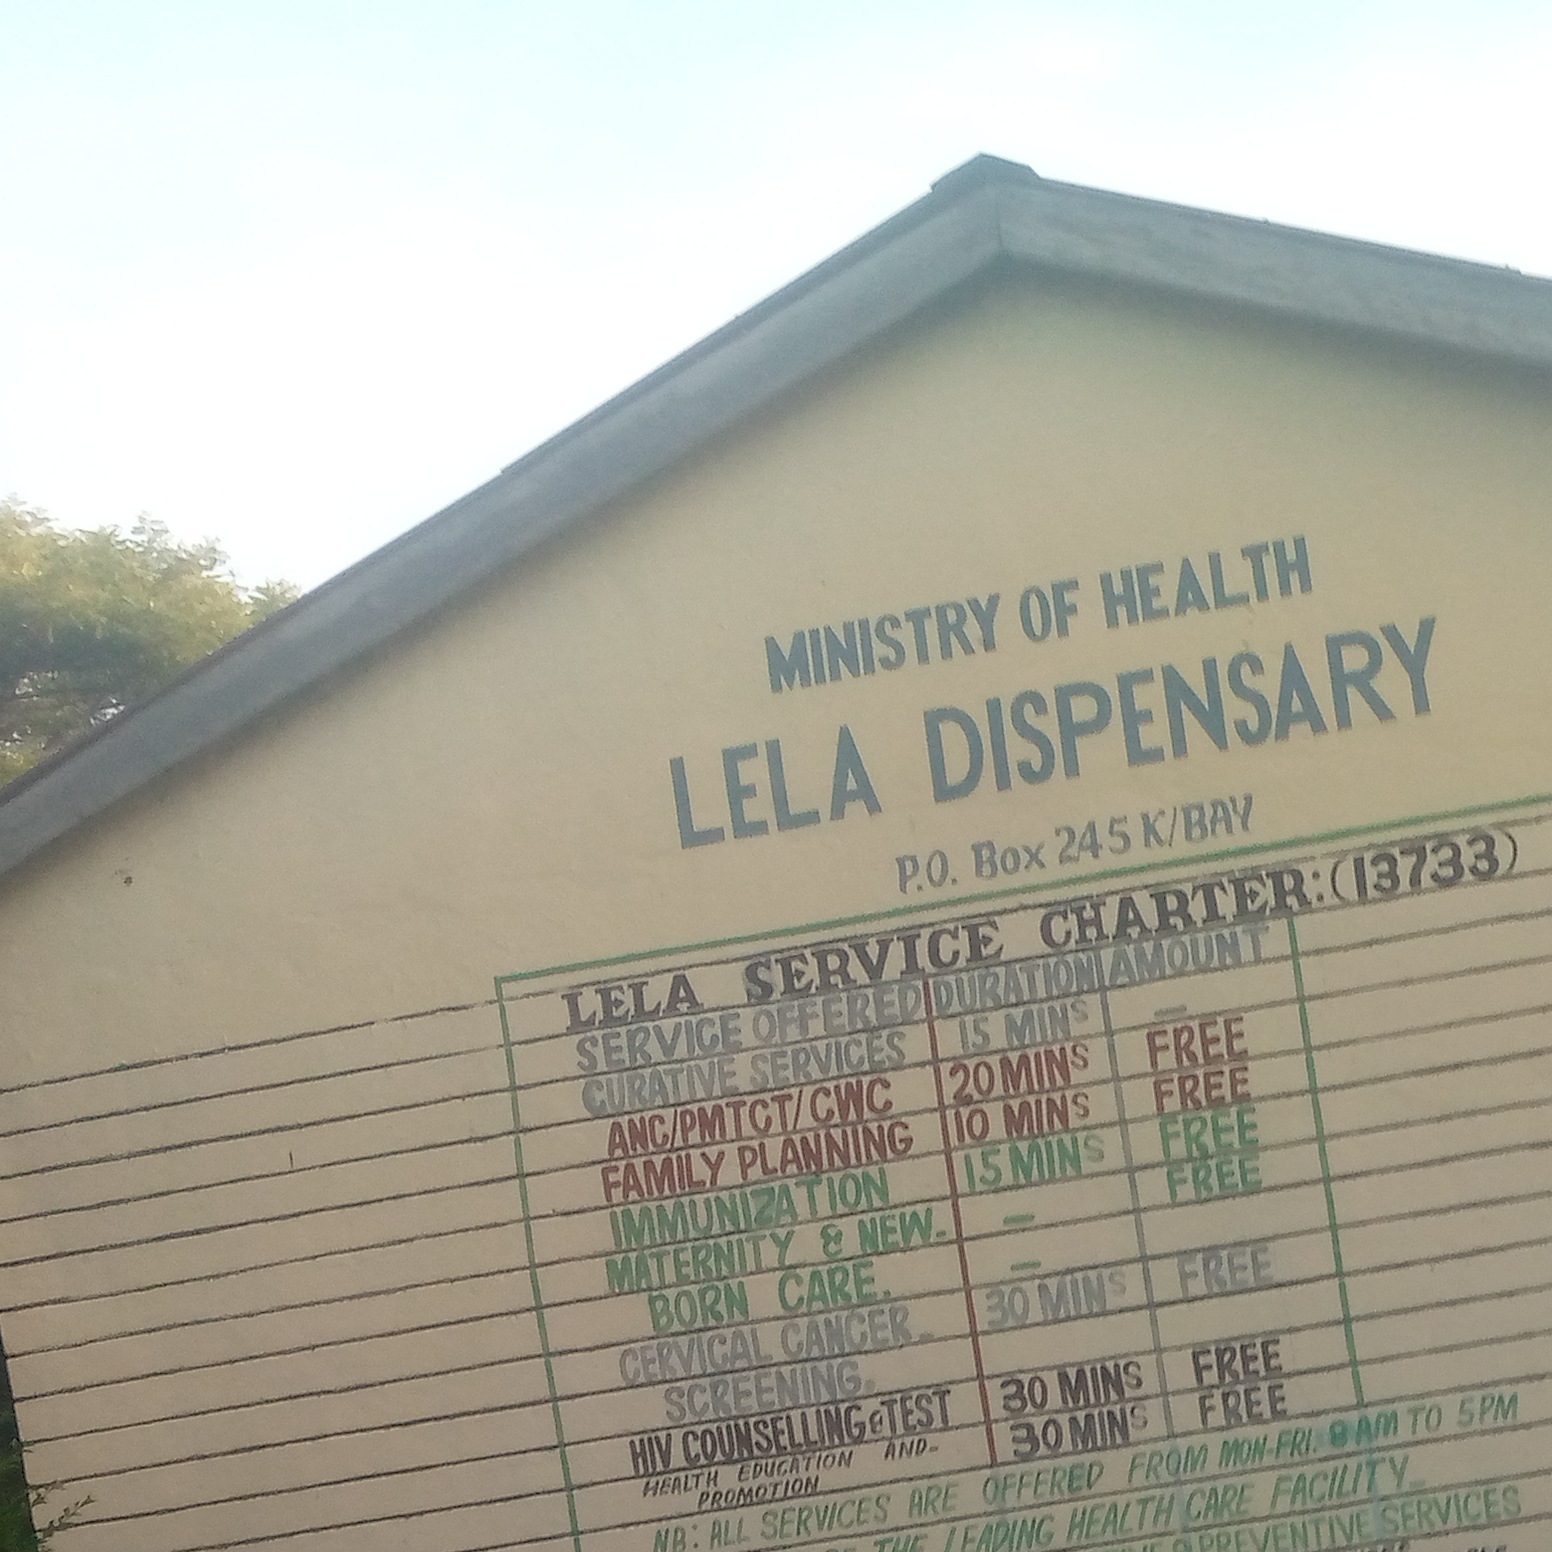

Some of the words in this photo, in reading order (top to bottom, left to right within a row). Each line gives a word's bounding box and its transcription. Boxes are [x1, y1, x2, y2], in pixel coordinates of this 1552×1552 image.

[764, 593, 1000, 693] MINISTRY
[1019, 579, 1080, 643] OF
[1101, 534, 1314, 631] HEALTH
[668, 724, 883, 851] LELA
[922, 616, 1438, 803] DISPENSARY
[896, 849, 958, 894] P.O.
[971, 840, 1046, 880] Box
[1054, 816, 1132, 865] 245
[1142, 795, 1254, 847] K/BAY
[560, 973, 704, 1034] LELA
[743, 916, 1004, 1003] SERVICE
[1108, 923, 1270, 985] AMOUNT
[933, 955, 1097, 1019] DURATION
[576, 1011, 742, 1073] SERVICE
[751, 980, 922, 1043] OFFERED
[959, 1015, 991, 1054] 15
[1004, 1000, 1089, 1047] MINS
[1145, 1016, 1249, 1071] FREE
[582, 1058, 739, 1117] CURATIVE
[750, 1030, 906, 1088] SERVICES
[949, 1060, 996, 1103] 20
[999, 1042, 1090, 1096] MINS
[1152, 1066, 1251, 1115] FREE
[606, 1077, 894, 1159] ANC/PMTCT/CWC
[953, 1107, 990, 1145] 10
[1002, 1091, 1091, 1138] MINS
[1158, 1104, 1260, 1162] FREE
[600, 1148, 726, 1203] FAMILY
[737, 1120, 915, 1181] PLANNING
[964, 1147, 1002, 1192] 15
[1008, 1132, 1105, 1183] MINS
[1164, 1152, 1263, 1202] FREE
[608, 1166, 889, 1250] IMMUNIZATION
[604, 1228, 796, 1295] MATERNITY
[819, 1223, 843, 1259] &
[1177, 1244, 1275, 1299] FREE
[646, 1280, 750, 1335] BORN
[985, 1286, 1030, 1332] 30
[1038, 1269, 1127, 1322] MINS
[618, 1328, 773, 1386] CERVICAL
[1191, 1338, 1283, 1387] FREE
[1000, 1376, 1047, 1416] 30
[1057, 1360, 1143, 1408] MINS
[1198, 1382, 1287, 1428] FREE
[629, 1433, 672, 1477] HIV
[682, 1402, 866, 1467] COUNSELLING
[1009, 1416, 1063, 1461] 30
[1068, 1402, 1148, 1451] MINS
[642, 1470, 718, 1498] HEALTH
[737, 1449, 854, 1482] EDUCATION
[697, 1474, 821, 1510] PROMOTION
[708, 1518, 749, 1549] ALL
[760, 1493, 892, 1542] SERVICES
[908, 1483, 959, 1519] ARE
[981, 1460, 1105, 1506] OFFERED
[1128, 1442, 1209, 1484] FROM
[1407, 1403, 1443, 1435] TO
[1457, 1391, 1519, 1428] 5PM
[1066, 1494, 1176, 1542] HEALTH
[1184, 1482, 1255, 1522] CARE
[1379, 1485, 1523, 1536] SERVICES
